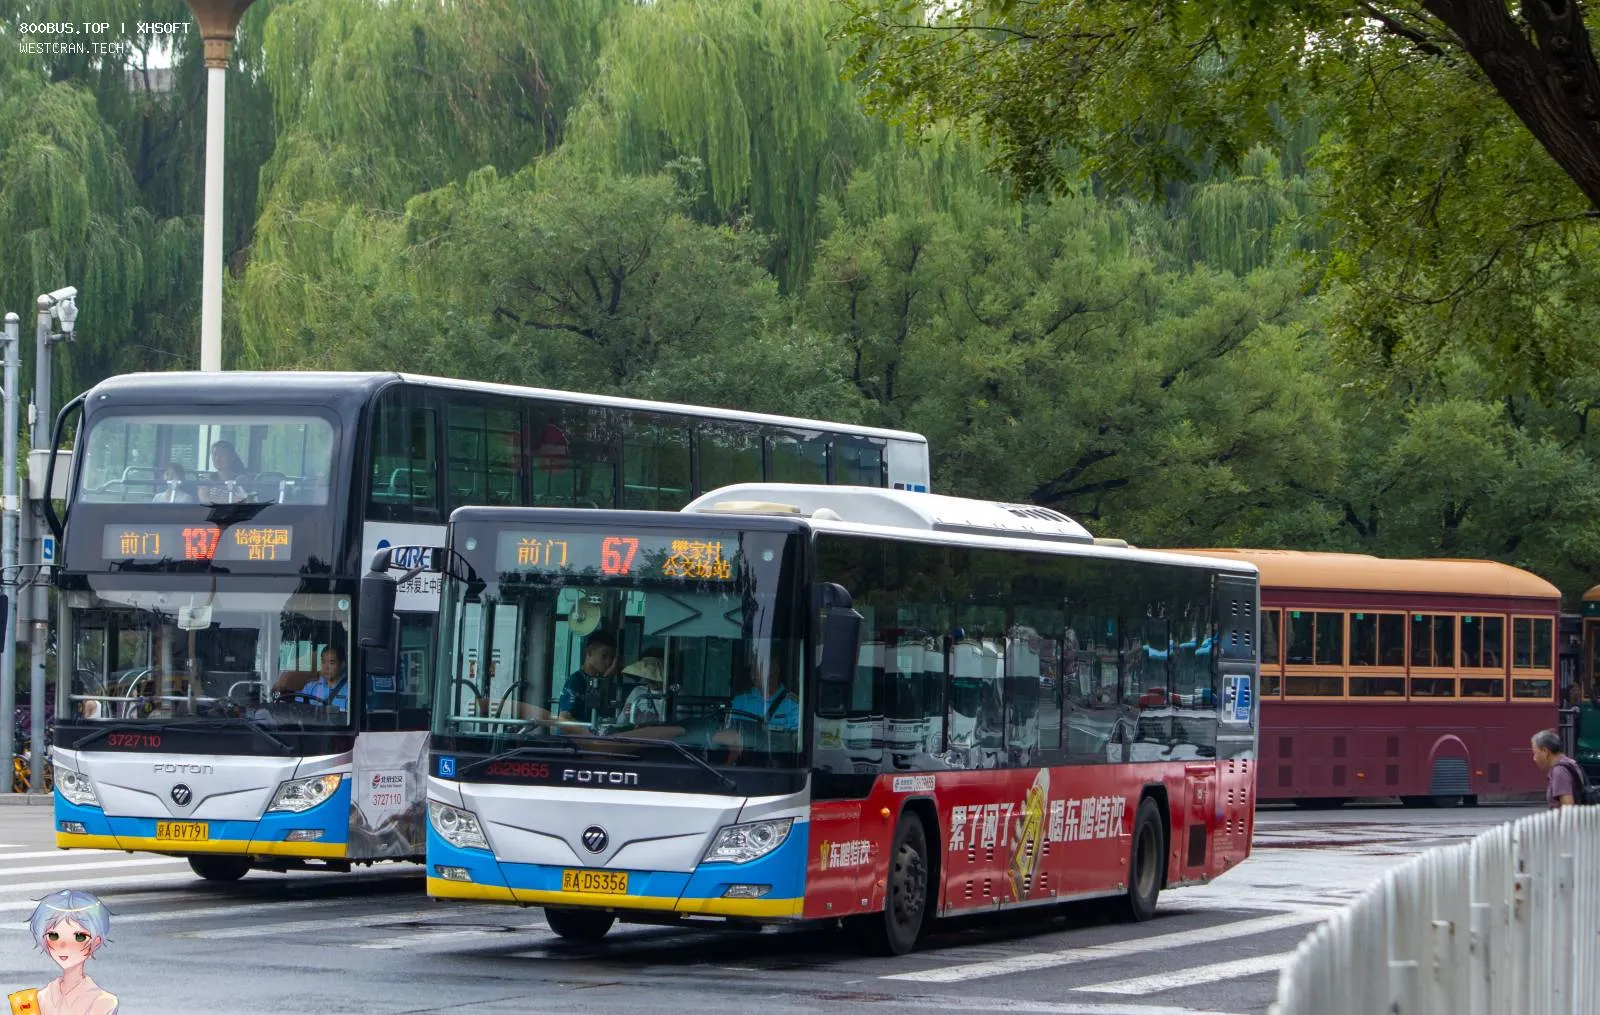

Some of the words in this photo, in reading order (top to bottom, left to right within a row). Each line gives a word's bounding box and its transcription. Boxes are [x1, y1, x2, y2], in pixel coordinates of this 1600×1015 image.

[119, 531, 161, 555] 前门
[182, 527, 221, 560] 137
[234, 528, 289, 545] 怡海花园
[248, 544, 275, 560] 西门
[517, 537, 568, 568] 前门
[601, 536, 640, 576] 67
[671, 539, 723, 562] 樊家村
[661, 557, 732, 579] 公交场站
[108, 733, 161, 749] 3727110
[153, 763, 214, 775] FOTON
[563, 769, 638, 785] FOTON
[372, 793, 402, 806] 3727110
[948, 803, 1015, 851] 累了困了
[1048, 795, 1127, 843] 喝东鹏特饮
[830, 839, 871, 868] 东鹏特饮
